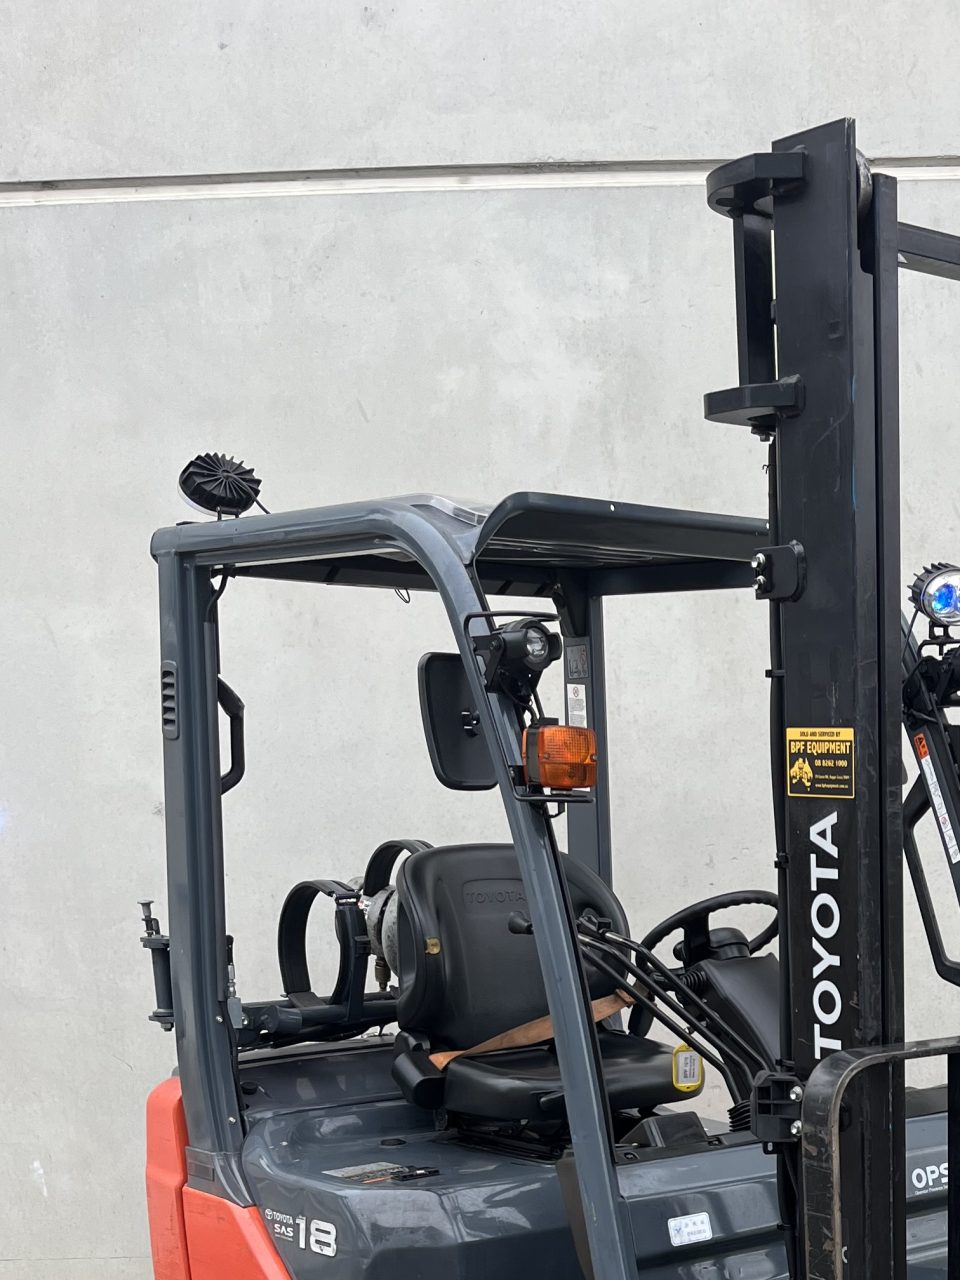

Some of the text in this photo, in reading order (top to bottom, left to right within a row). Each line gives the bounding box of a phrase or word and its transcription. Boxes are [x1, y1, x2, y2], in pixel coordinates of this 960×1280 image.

[790, 741, 850, 755] BPF EQUIPMENT
[810, 811, 842, 1060] TOYOTA
[273, 1211, 337, 1257] TOYOTA 18
[274, 1223, 294, 1237] SAS
